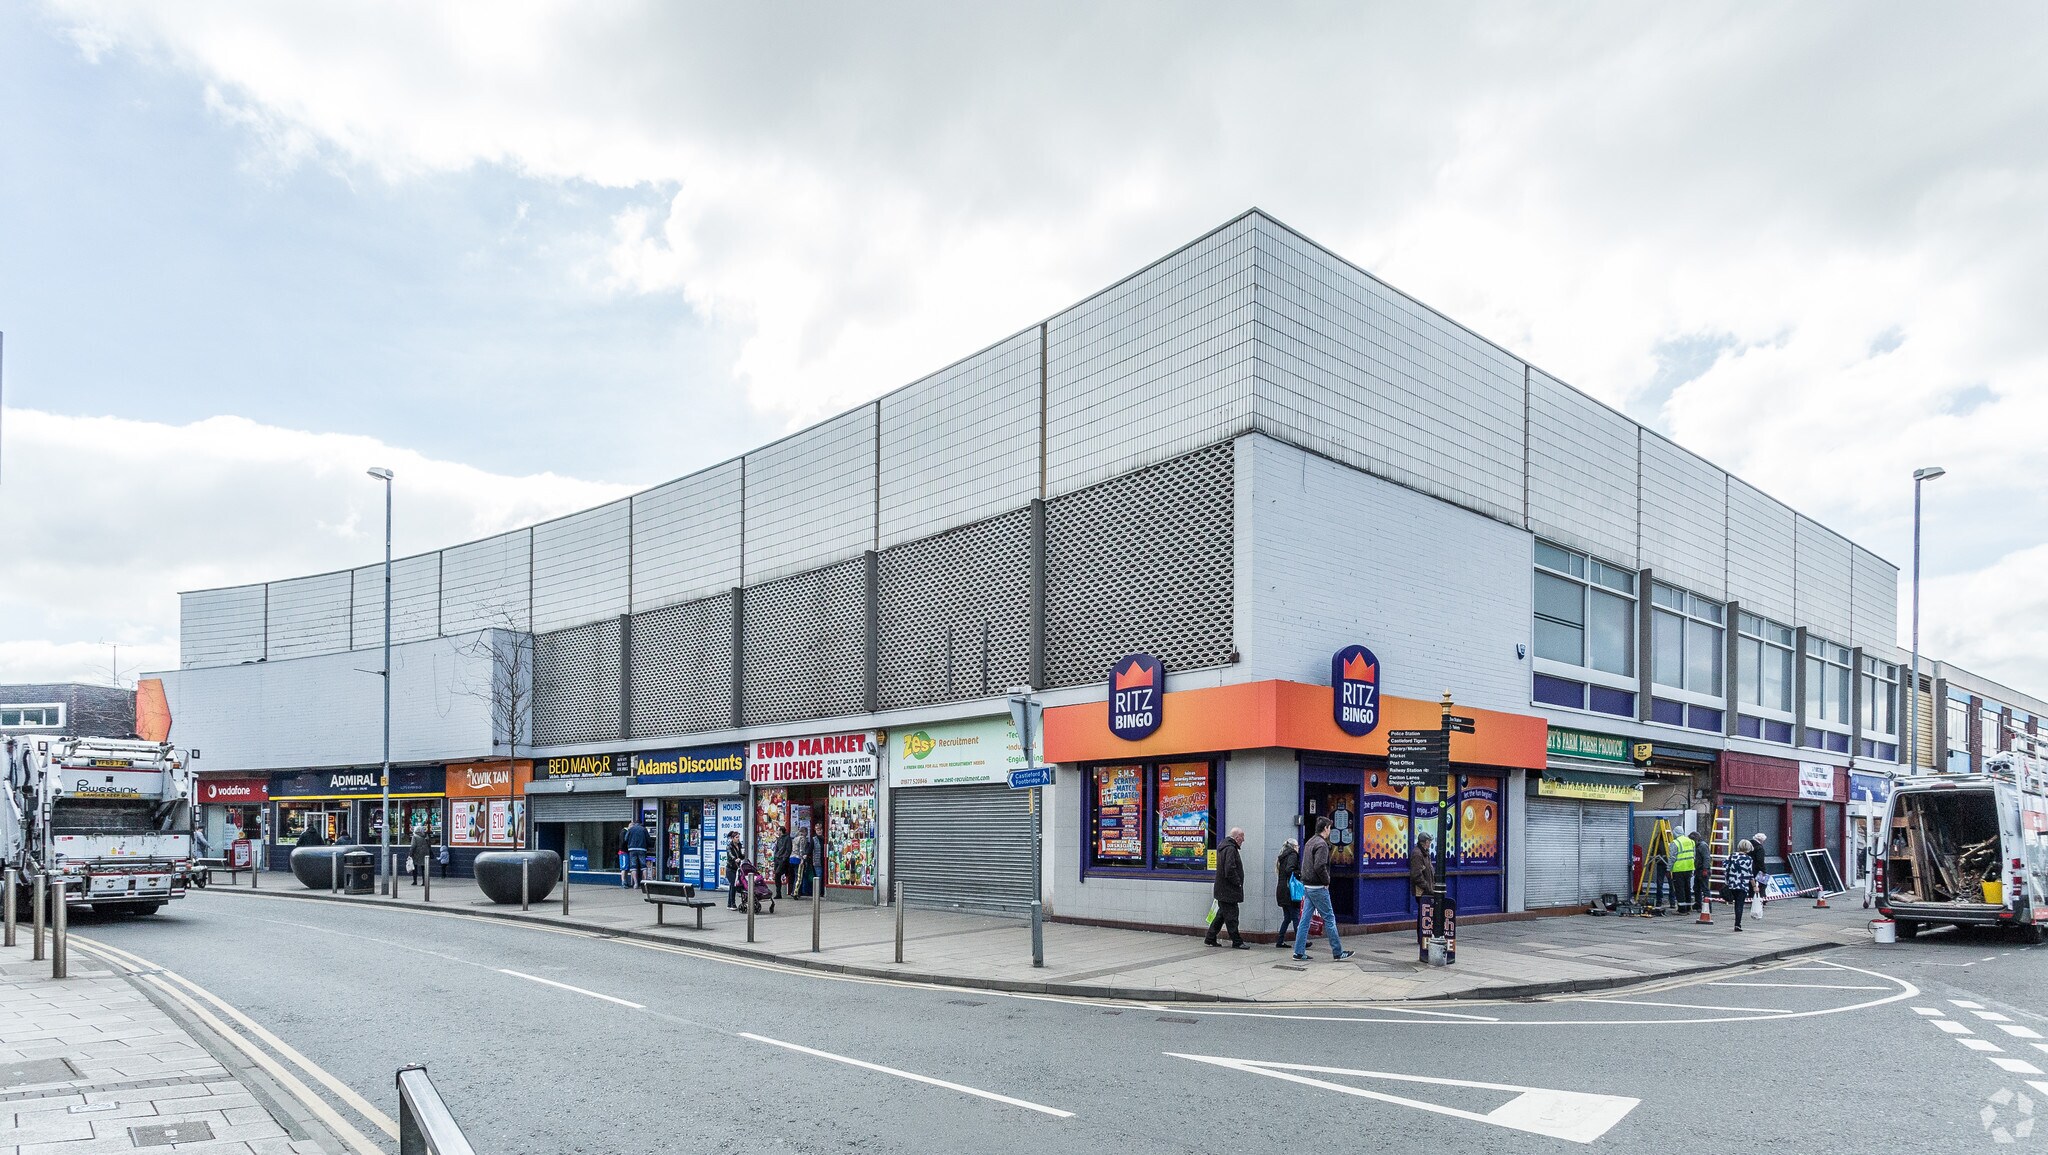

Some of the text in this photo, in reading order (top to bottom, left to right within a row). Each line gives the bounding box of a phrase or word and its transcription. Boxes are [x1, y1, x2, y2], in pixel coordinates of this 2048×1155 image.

[1116, 689, 1152, 713] RITZ
[1343, 682, 1374, 707] RITZ
[1116, 712, 1153, 729] BINGO
[1343, 707, 1374, 724] BINGO
[757, 734, 865, 759] EURO MARKET
[939, 736, 979, 748] Recruitment
[1580, 734, 1597, 752] FRESH
[1598, 738, 1622, 757] PRODUCE
[549, 756, 610, 776] BED MANOR
[637, 754, 742, 776] Adams Discounts
[751, 760, 823, 782] OFF LICENCE
[827, 766, 840, 778] 9AM
[848, 765, 871, 777] 8.30PM
[330, 773, 377, 788] ADMIRAL
[472, 771, 509, 785] KWIK TAN
[1015, 771, 1040, 779] Castleford
[218, 785, 250, 795] vodafone
[830, 785, 844, 797] OFF
[1371, 801, 1382, 809] game
[1383, 800, 1395, 808] starts
[455, 814, 466, 829] £10
[493, 813, 504, 829] £10
